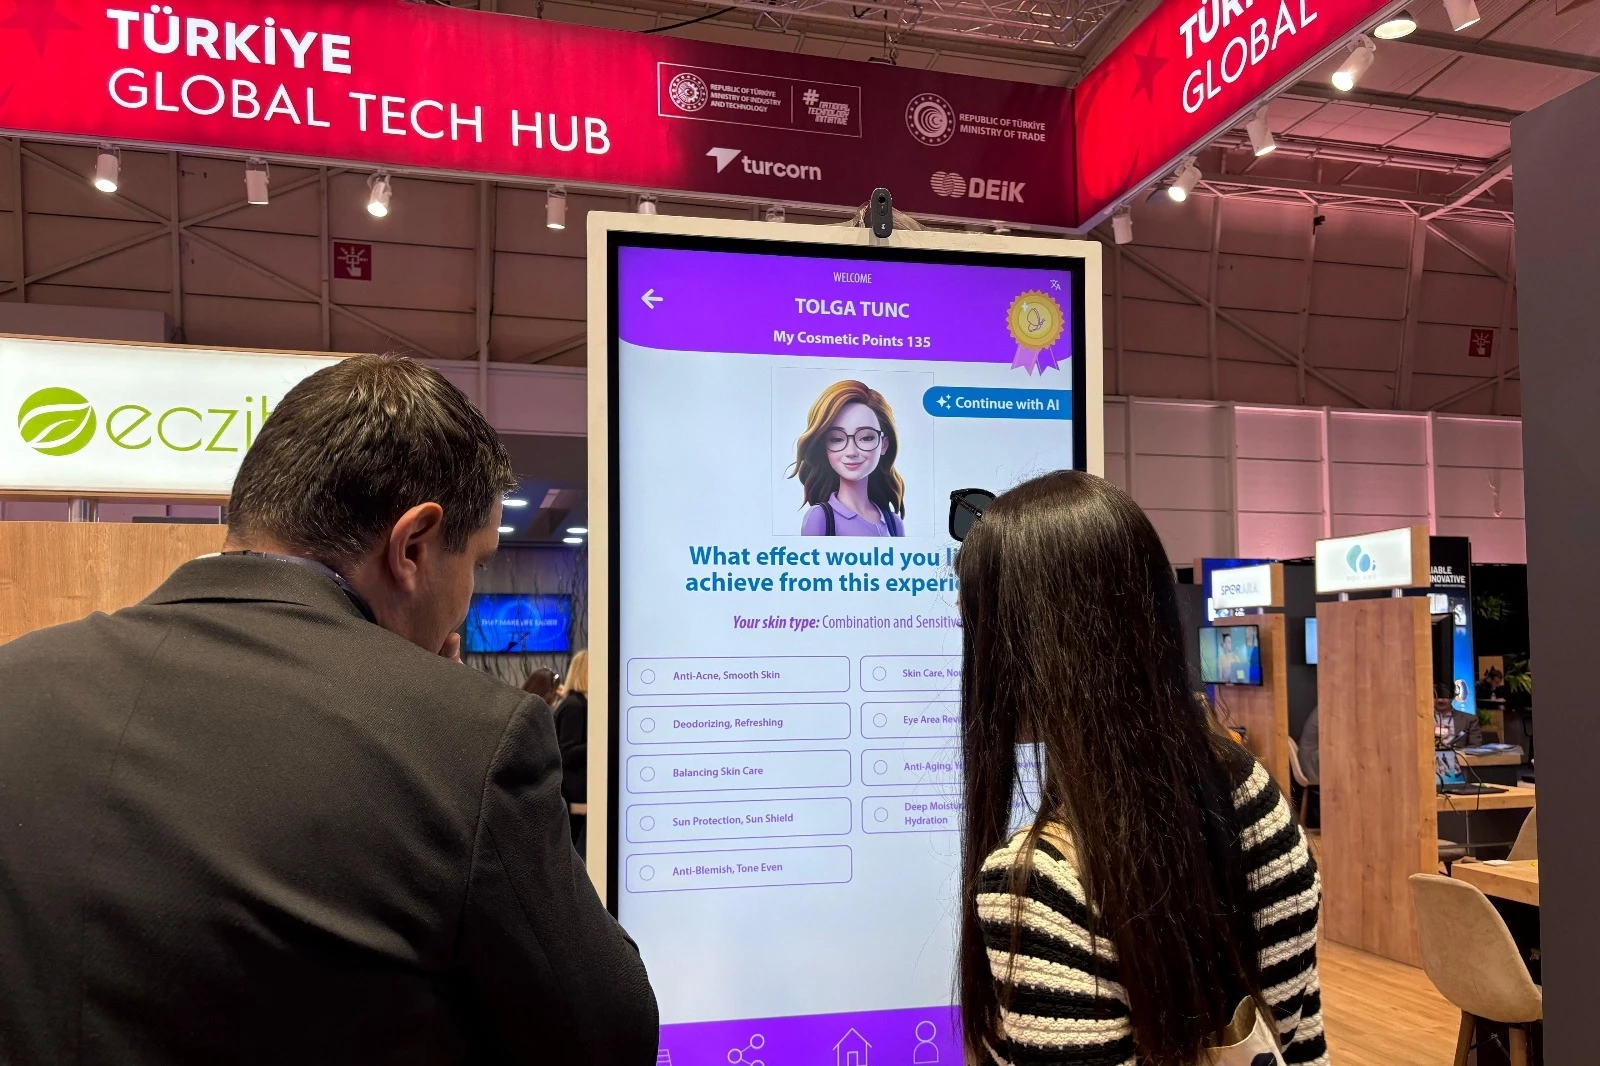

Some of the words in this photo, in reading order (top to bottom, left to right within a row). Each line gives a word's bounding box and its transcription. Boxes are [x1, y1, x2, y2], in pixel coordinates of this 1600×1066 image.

[106, 4, 352, 74] TÜRKİYE
[1183, 0, 1317, 113] GLOBAL
[710, 84, 740, 93] REPUBLIC
[710, 92, 740, 101] MINISTRY
[750, 97, 781, 106] INDUSTRY
[108, 67, 331, 128] GLOBAL
[349, 91, 482, 143] TECH
[511, 109, 610, 155] HUB
[726, 102, 768, 112] TECHNOLOGY
[959, 113, 998, 126] REPUBLIC
[1000, 118, 1011, 127] OF
[1012, 118, 1045, 131] TÜRKİYE
[960, 124, 1001, 137] MINISTRY
[1003, 130, 1015, 138] OF
[1017, 131, 1046, 142] TRADE
[742, 155, 822, 181] turcorn
[833, 272, 872, 284] WELCOME
[795, 297, 856, 316] TOLGA
[860, 301, 910, 318] TUNC
[773, 330, 794, 345] My
[797, 330, 859, 345] Cosmetic
[862, 334, 903, 347] Points
[907, 336, 931, 348] 135
[955, 396, 1013, 411] Continue
[1016, 397, 1043, 411] with
[1047, 398, 1060, 411] AI
[689, 546, 750, 566] What
[756, 546, 820, 566] effect
[826, 547, 894, 566] would
[900, 551, 940, 571] you
[1430, 565, 1452, 574] IABLE
[685, 572, 774, 592] achieve
[779, 572, 833, 591] from
[839, 573, 880, 592] this
[1430, 574, 1466, 584] NOVATIVE
[733, 615, 760, 629] Your
[762, 615, 787, 629] skin
[789, 616, 819, 632] type:
[822, 615, 890, 629] Combination
[893, 615, 913, 629] and
[673, 671, 721, 681] Anti-Acne,
[723, 671, 759, 680] Smooth
[761, 670, 780, 679] Skin
[902, 669, 921, 678] Skin
[923, 669, 945, 678] Care,
[673, 719, 732, 729] Deodorizing,
[735, 718, 783, 728] Refreshing
[903, 716, 918, 725] Eye
[921, 715, 940, 724] Area
[673, 768, 719, 778] Balancing
[721, 768, 740, 776] Skin
[743, 767, 763, 775] Care
[904, 762, 952, 772] Anti-Aging,
[904, 803, 927, 812] Deep
[673, 817, 690, 826] Sun
[693, 816, 744, 826] Protection,
[745, 815, 763, 823] Sun
[765, 814, 793, 823] Shield
[904, 816, 948, 826] Hydration
[673, 865, 735, 876] Anti-Blemish,
[737, 864, 759, 873] Tone
[761, 863, 783, 871] Even
